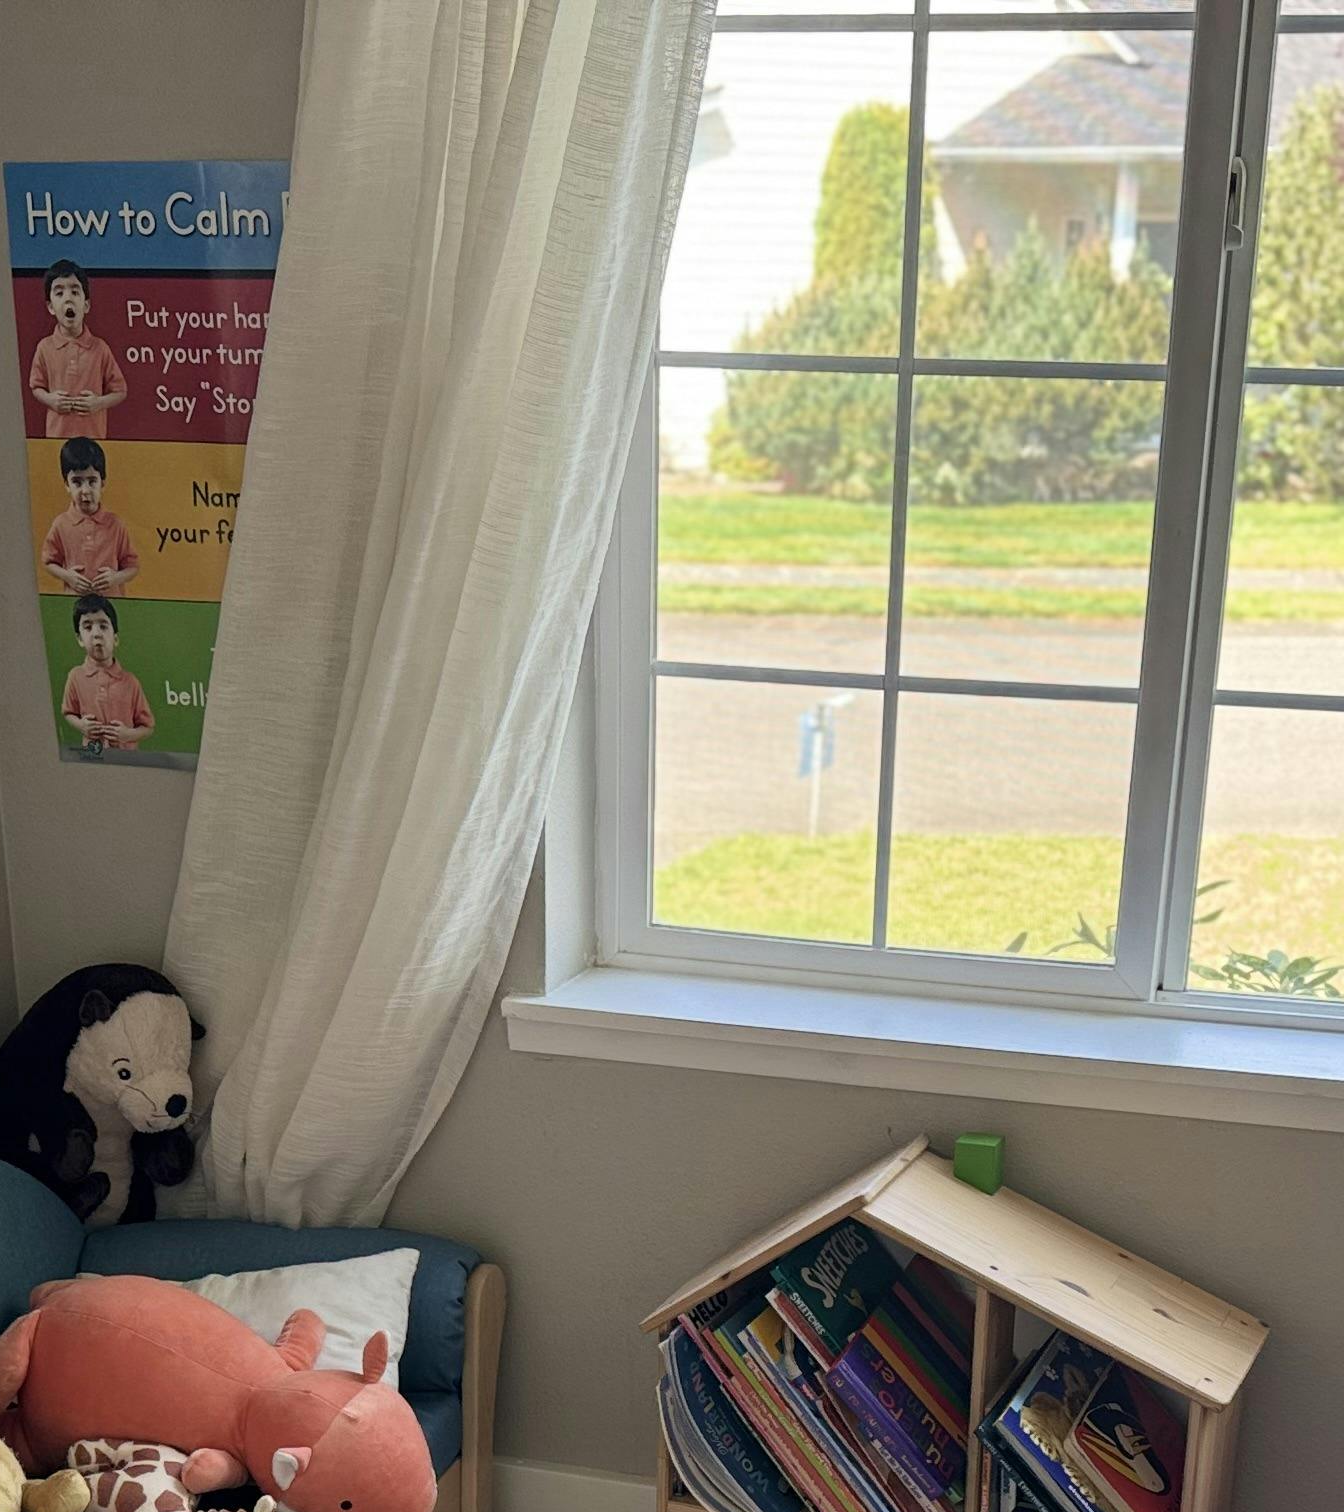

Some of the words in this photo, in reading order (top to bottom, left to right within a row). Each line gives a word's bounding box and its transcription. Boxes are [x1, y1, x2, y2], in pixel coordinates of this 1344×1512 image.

[25, 191, 109, 236] How
[118, 201, 156, 236] to
[165, 191, 270, 236] Calm
[126, 300, 169, 328] Put
[176, 311, 227, 339] your
[126, 346, 155, 363] on
[160, 347, 212, 373] your
[156, 386, 196, 423] Say
[156, 528, 210, 552] your
[166, 680, 208, 706] bell
[801, 1225, 868, 1308] SNEETCHES
[688, 1290, 730, 1331] HELLO
[690, 1361, 770, 1492] WONDERLAND
